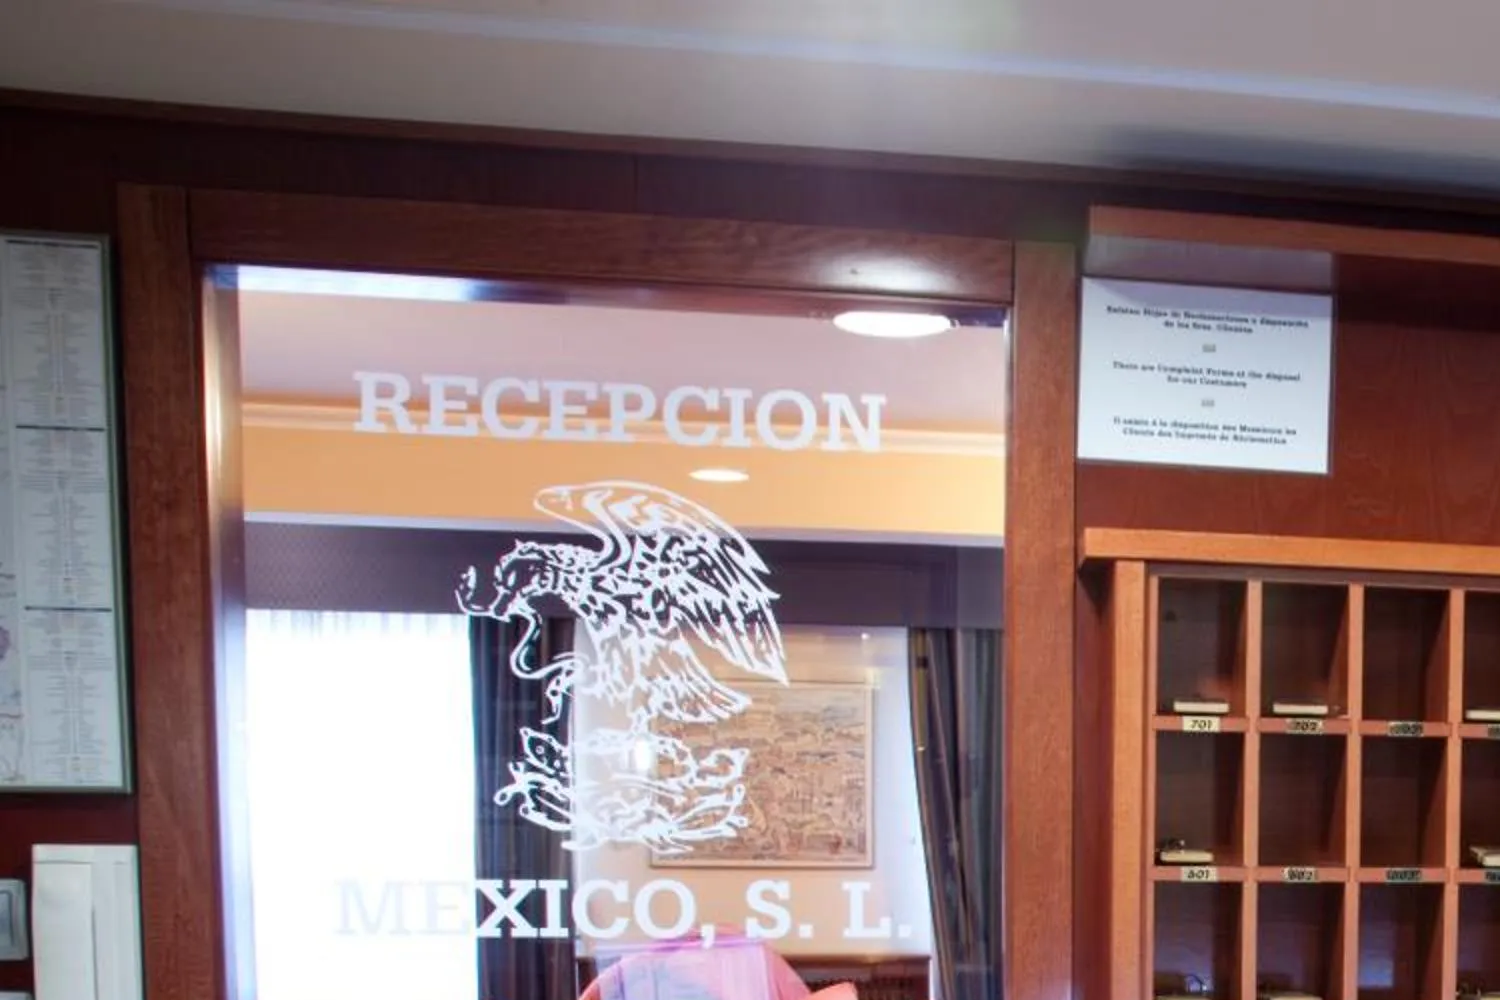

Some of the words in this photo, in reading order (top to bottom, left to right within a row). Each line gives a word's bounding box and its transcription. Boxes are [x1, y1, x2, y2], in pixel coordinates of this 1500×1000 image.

[353, 370, 886, 453] RECEPCION
[333, 877, 715, 949] MEXICO,
[746, 881, 812, 939] S.
[842, 881, 912, 938] L.
